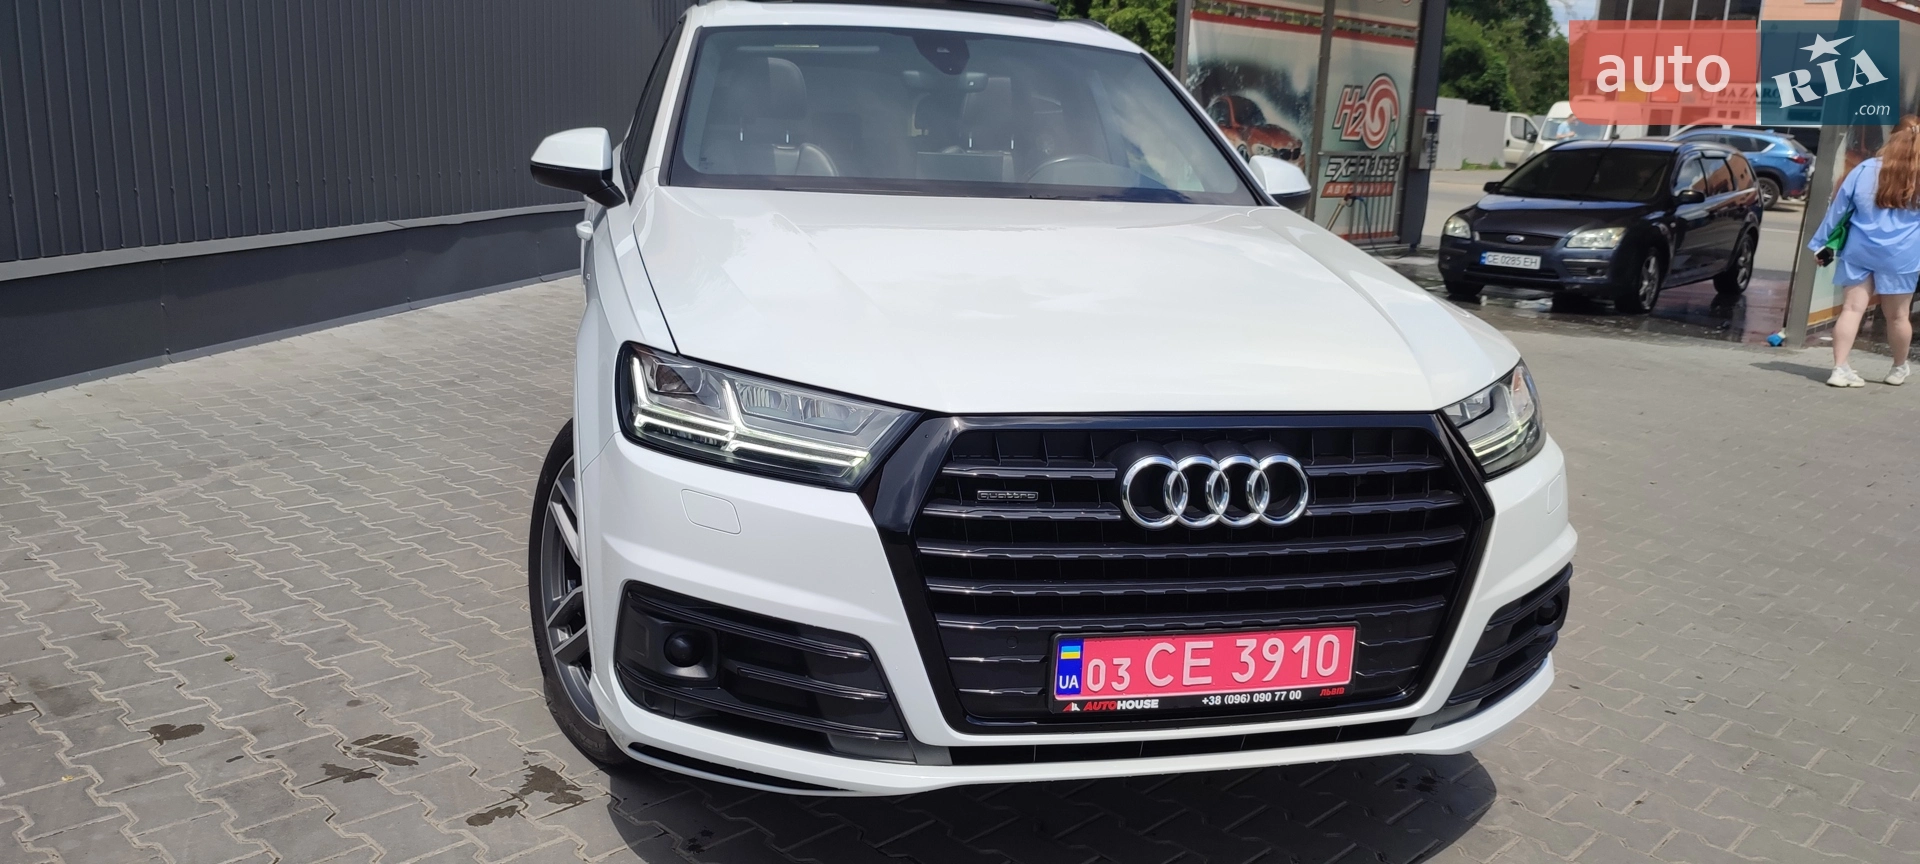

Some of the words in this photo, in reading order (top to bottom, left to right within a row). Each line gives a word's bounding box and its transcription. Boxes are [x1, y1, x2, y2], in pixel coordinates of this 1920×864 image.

[1486, 254, 1500, 264] CE
[1523, 257, 1538, 267] EH
[981, 492, 1036, 500] quattro
[1059, 675, 1079, 689] UA
[1087, 657, 1132, 692] 03
[1145, 640, 1214, 688] CE
[1231, 634, 1340, 683] 3910
[1319, 687, 1345, 696] ЛЬВІВ
[1202, 696, 1222, 706] +38
[1224, 693, 1251, 705] (096)
[1253, 692, 1273, 703] 090
[1274, 691, 1288, 701] 77
[1289, 690, 1302, 700] 00
[1083, 699, 1159, 711] AUTOHOUSE
